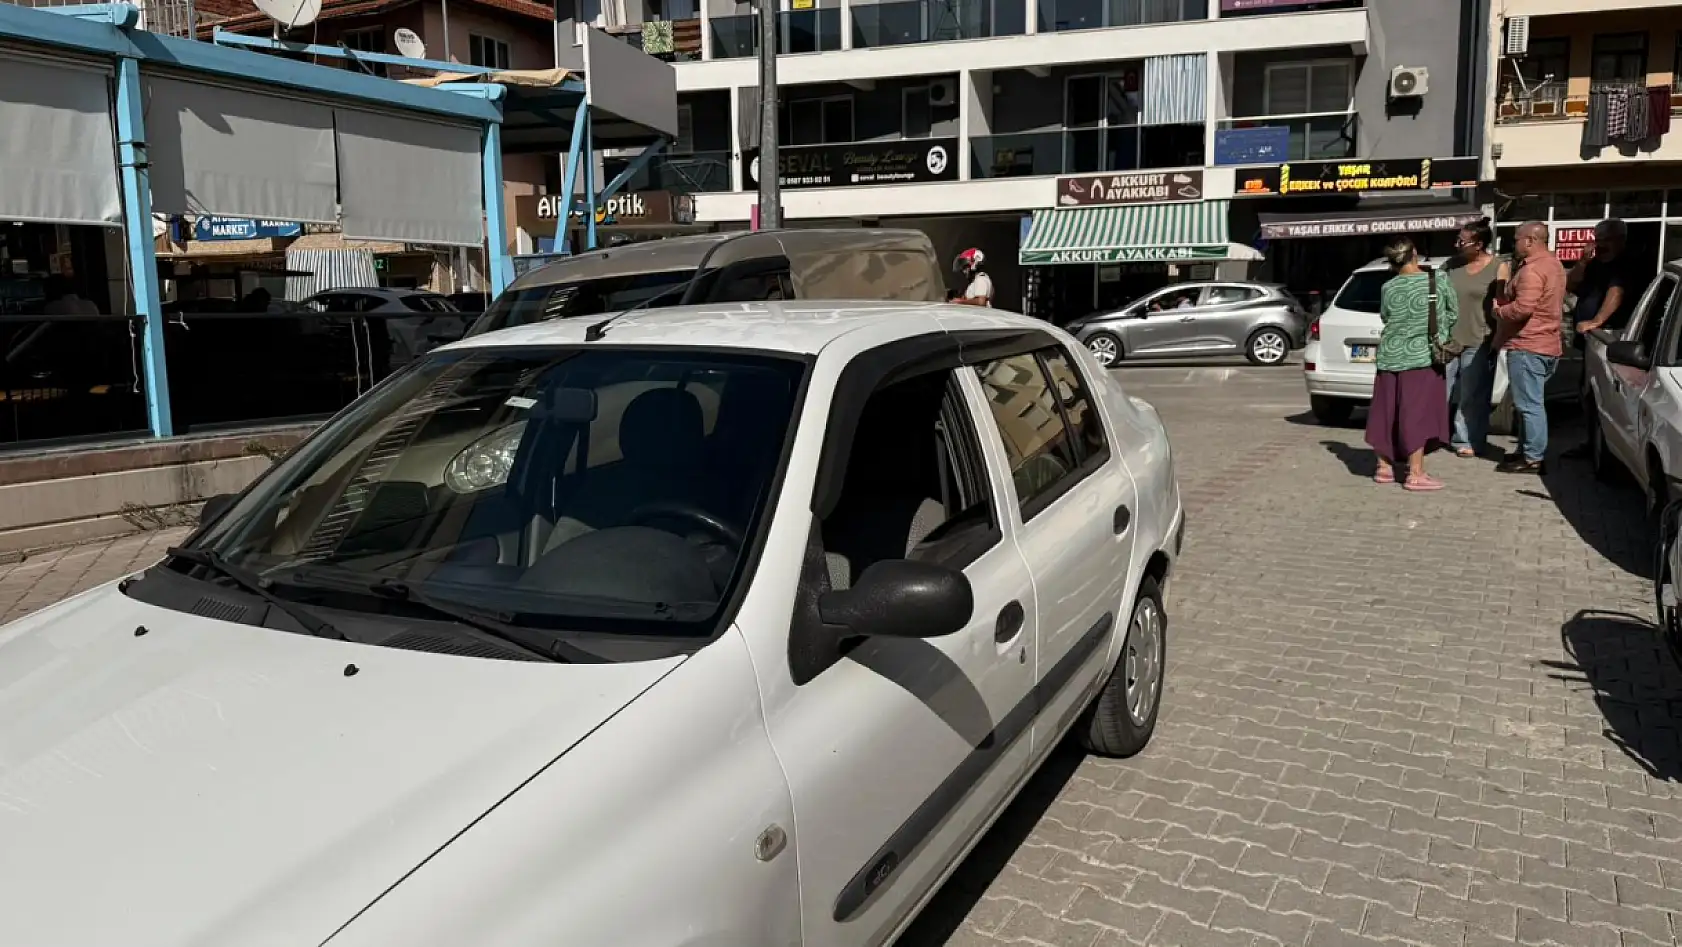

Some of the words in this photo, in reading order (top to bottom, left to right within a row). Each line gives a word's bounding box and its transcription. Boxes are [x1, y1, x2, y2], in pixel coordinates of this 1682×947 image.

[1111, 174, 1167, 187] AKKURT
[1106, 185, 1169, 200] AYAKKABI
[212, 224, 248, 236] MARKET
[1288, 224, 1320, 237] YAŞAR
[1322, 222, 1354, 234] ERKEK
[1356, 224, 1368, 232] ve
[1371, 220, 1405, 233] ÇOCUK
[1558, 229, 1596, 241] UFUK
[1050, 249, 1112, 263] AKKURT
[1115, 247, 1193, 260] AYAKKABI
